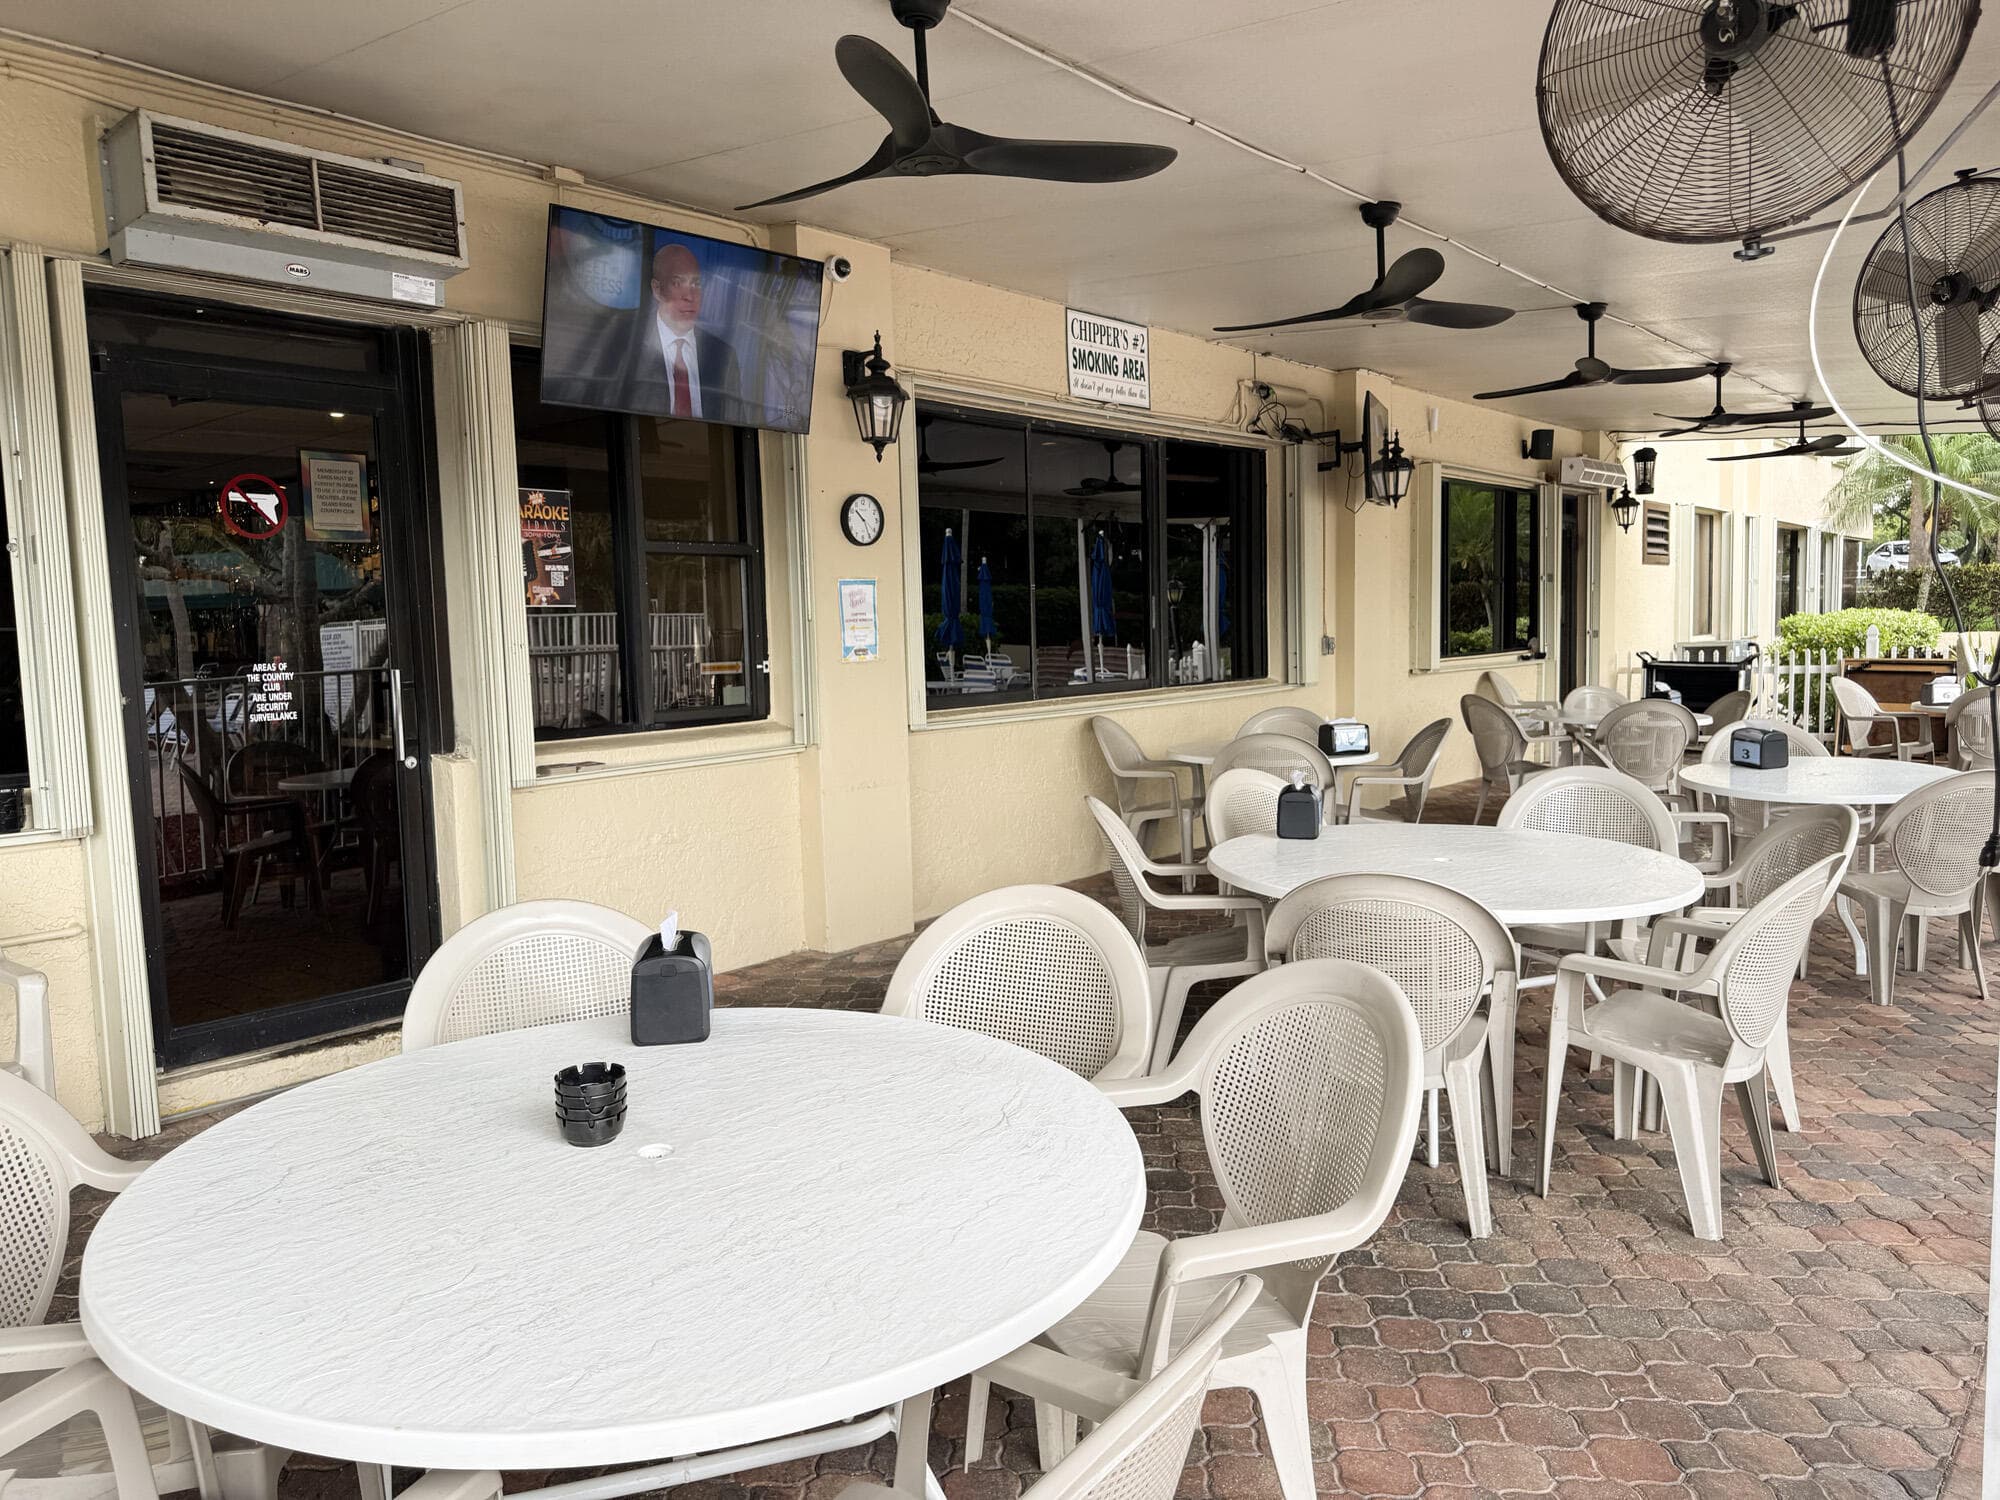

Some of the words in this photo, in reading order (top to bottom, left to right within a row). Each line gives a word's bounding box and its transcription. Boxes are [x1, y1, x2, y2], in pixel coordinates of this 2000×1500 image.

[289, 266, 309, 275] MARS
[1071, 318, 1129, 350] CHIPPER'S
[1132, 333, 1145, 353] #2
[1072, 347, 1119, 376] SMOKING
[1122, 357, 1146, 382] AREA
[522, 520, 566, 532] IDAYS
[252, 663, 277, 672] AREAS
[278, 662, 287, 671] OF
[246, 673, 260, 682] THE
[262, 672, 294, 681] COUNTRY
[262, 683, 280, 692] CLUB
[252, 693, 266, 702] ARE
[268, 692, 292, 701] UNDER
[256, 702, 289, 712] SECURITY
[250, 711, 298, 722] SURVEILLANCE
[1742, 749, 1750, 759] 3
